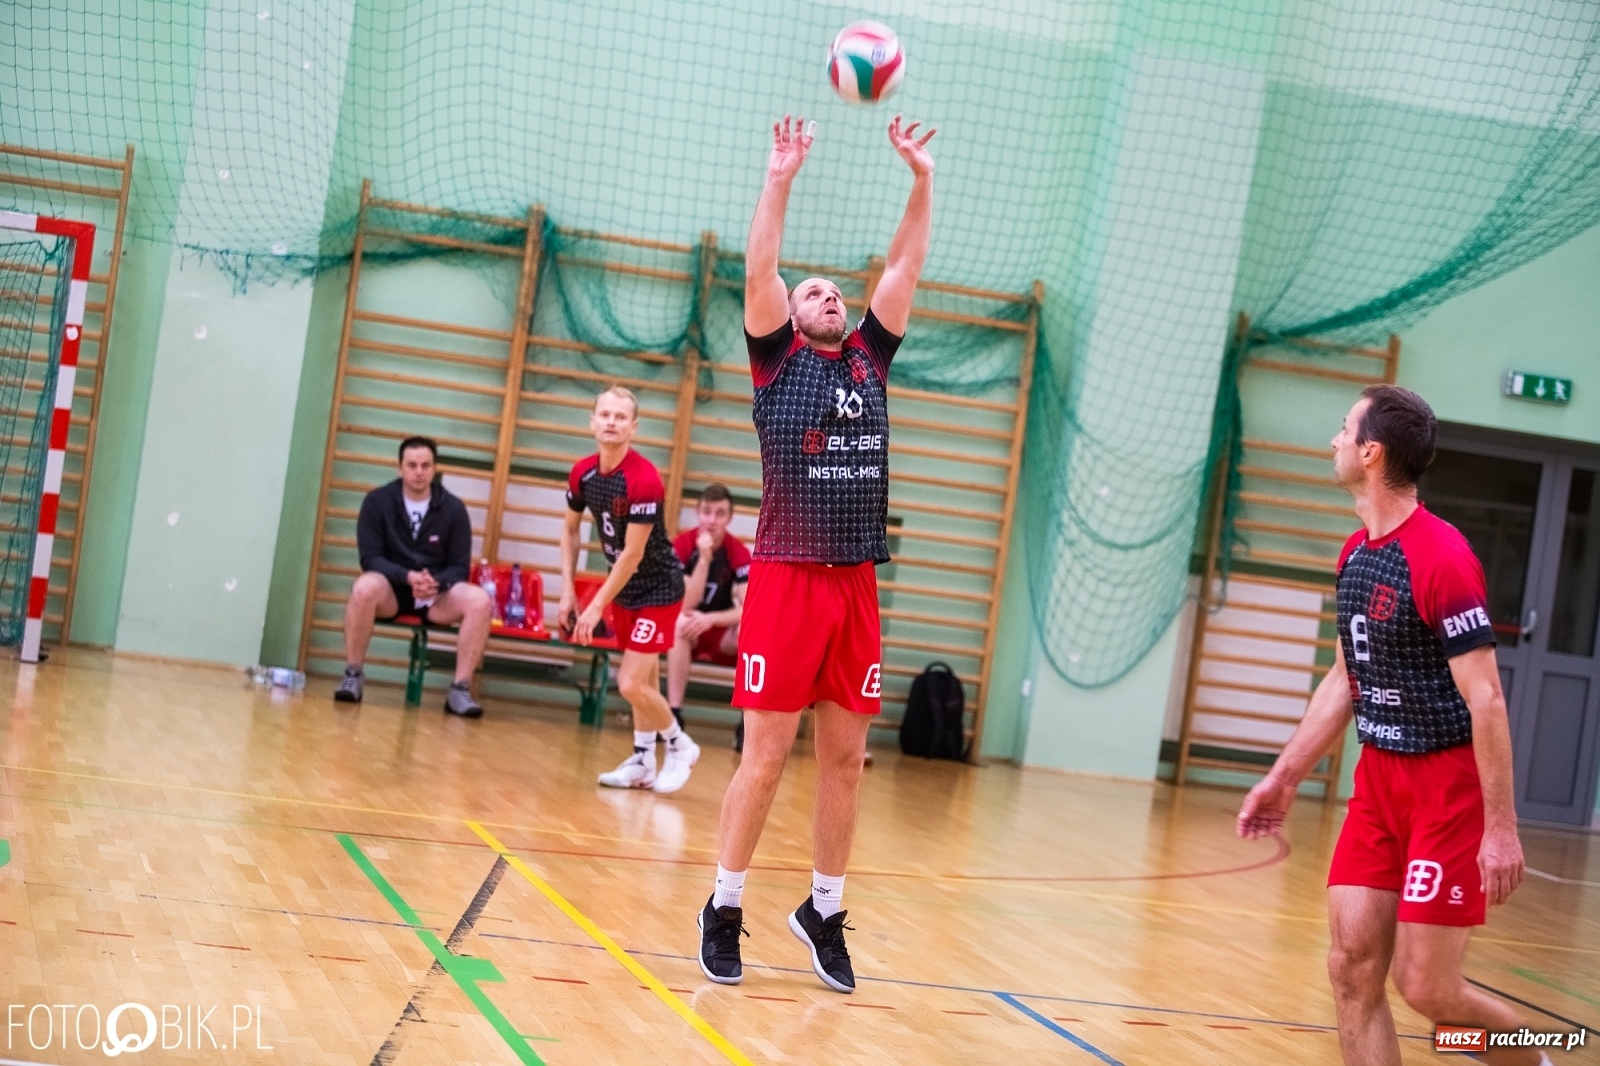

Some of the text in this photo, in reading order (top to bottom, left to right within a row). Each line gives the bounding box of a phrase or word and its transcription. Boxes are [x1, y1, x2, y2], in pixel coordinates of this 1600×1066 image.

[835, 388, 864, 419] 10
[808, 466, 880, 479] INSTAL-MAG
[602, 511, 616, 537] 6
[705, 582, 718, 605] 7
[1442, 606, 1491, 639] ENTE
[742, 652, 766, 694] 10
